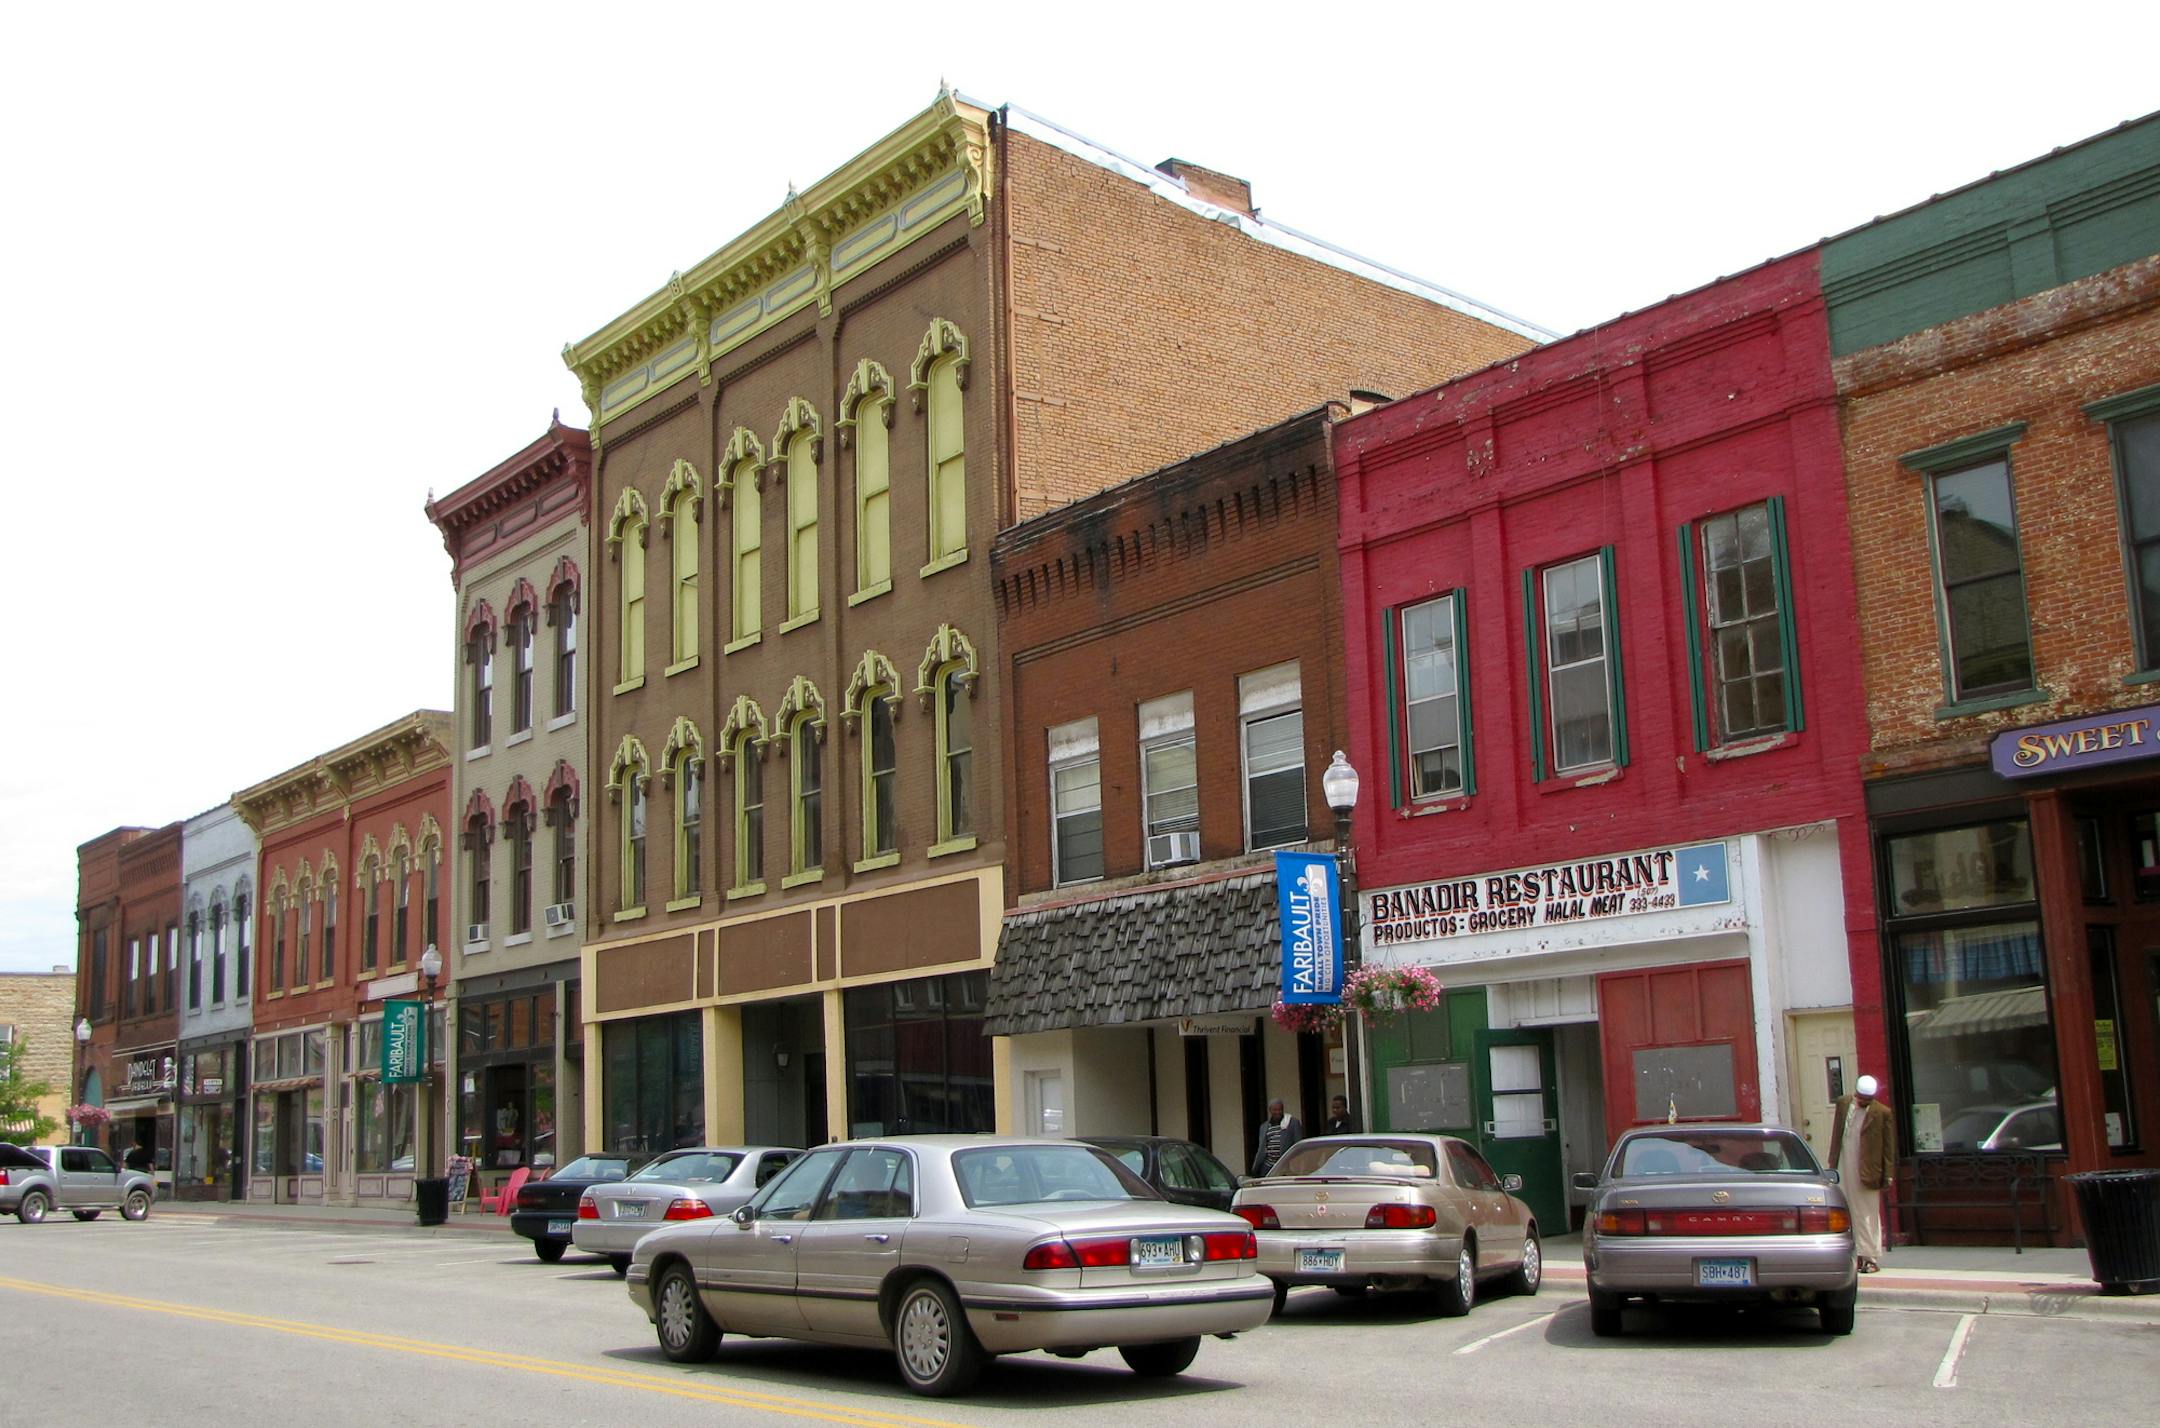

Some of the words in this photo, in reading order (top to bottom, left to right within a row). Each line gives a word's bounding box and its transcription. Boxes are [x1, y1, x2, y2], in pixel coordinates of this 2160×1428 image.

[2012, 719, 2150, 768] SWEET
[1371, 880, 1479, 924] BANADIR
[1485, 850, 1674, 910] RESTAURANT
[1314, 896, 1322, 925] PRIDE
[1469, 905, 1537, 933] GROCERY
[1544, 899, 1586, 923] HALAL
[1590, 893, 1626, 918] MEAT
[1629, 893, 1676, 912] 333-4433
[1290, 891, 1314, 994] FARIBAULT
[1316, 927, 1324, 957] TOWN
[389, 1022, 405, 1078] FARIBAULT
[1221, 1023, 1251, 1034] Financial
